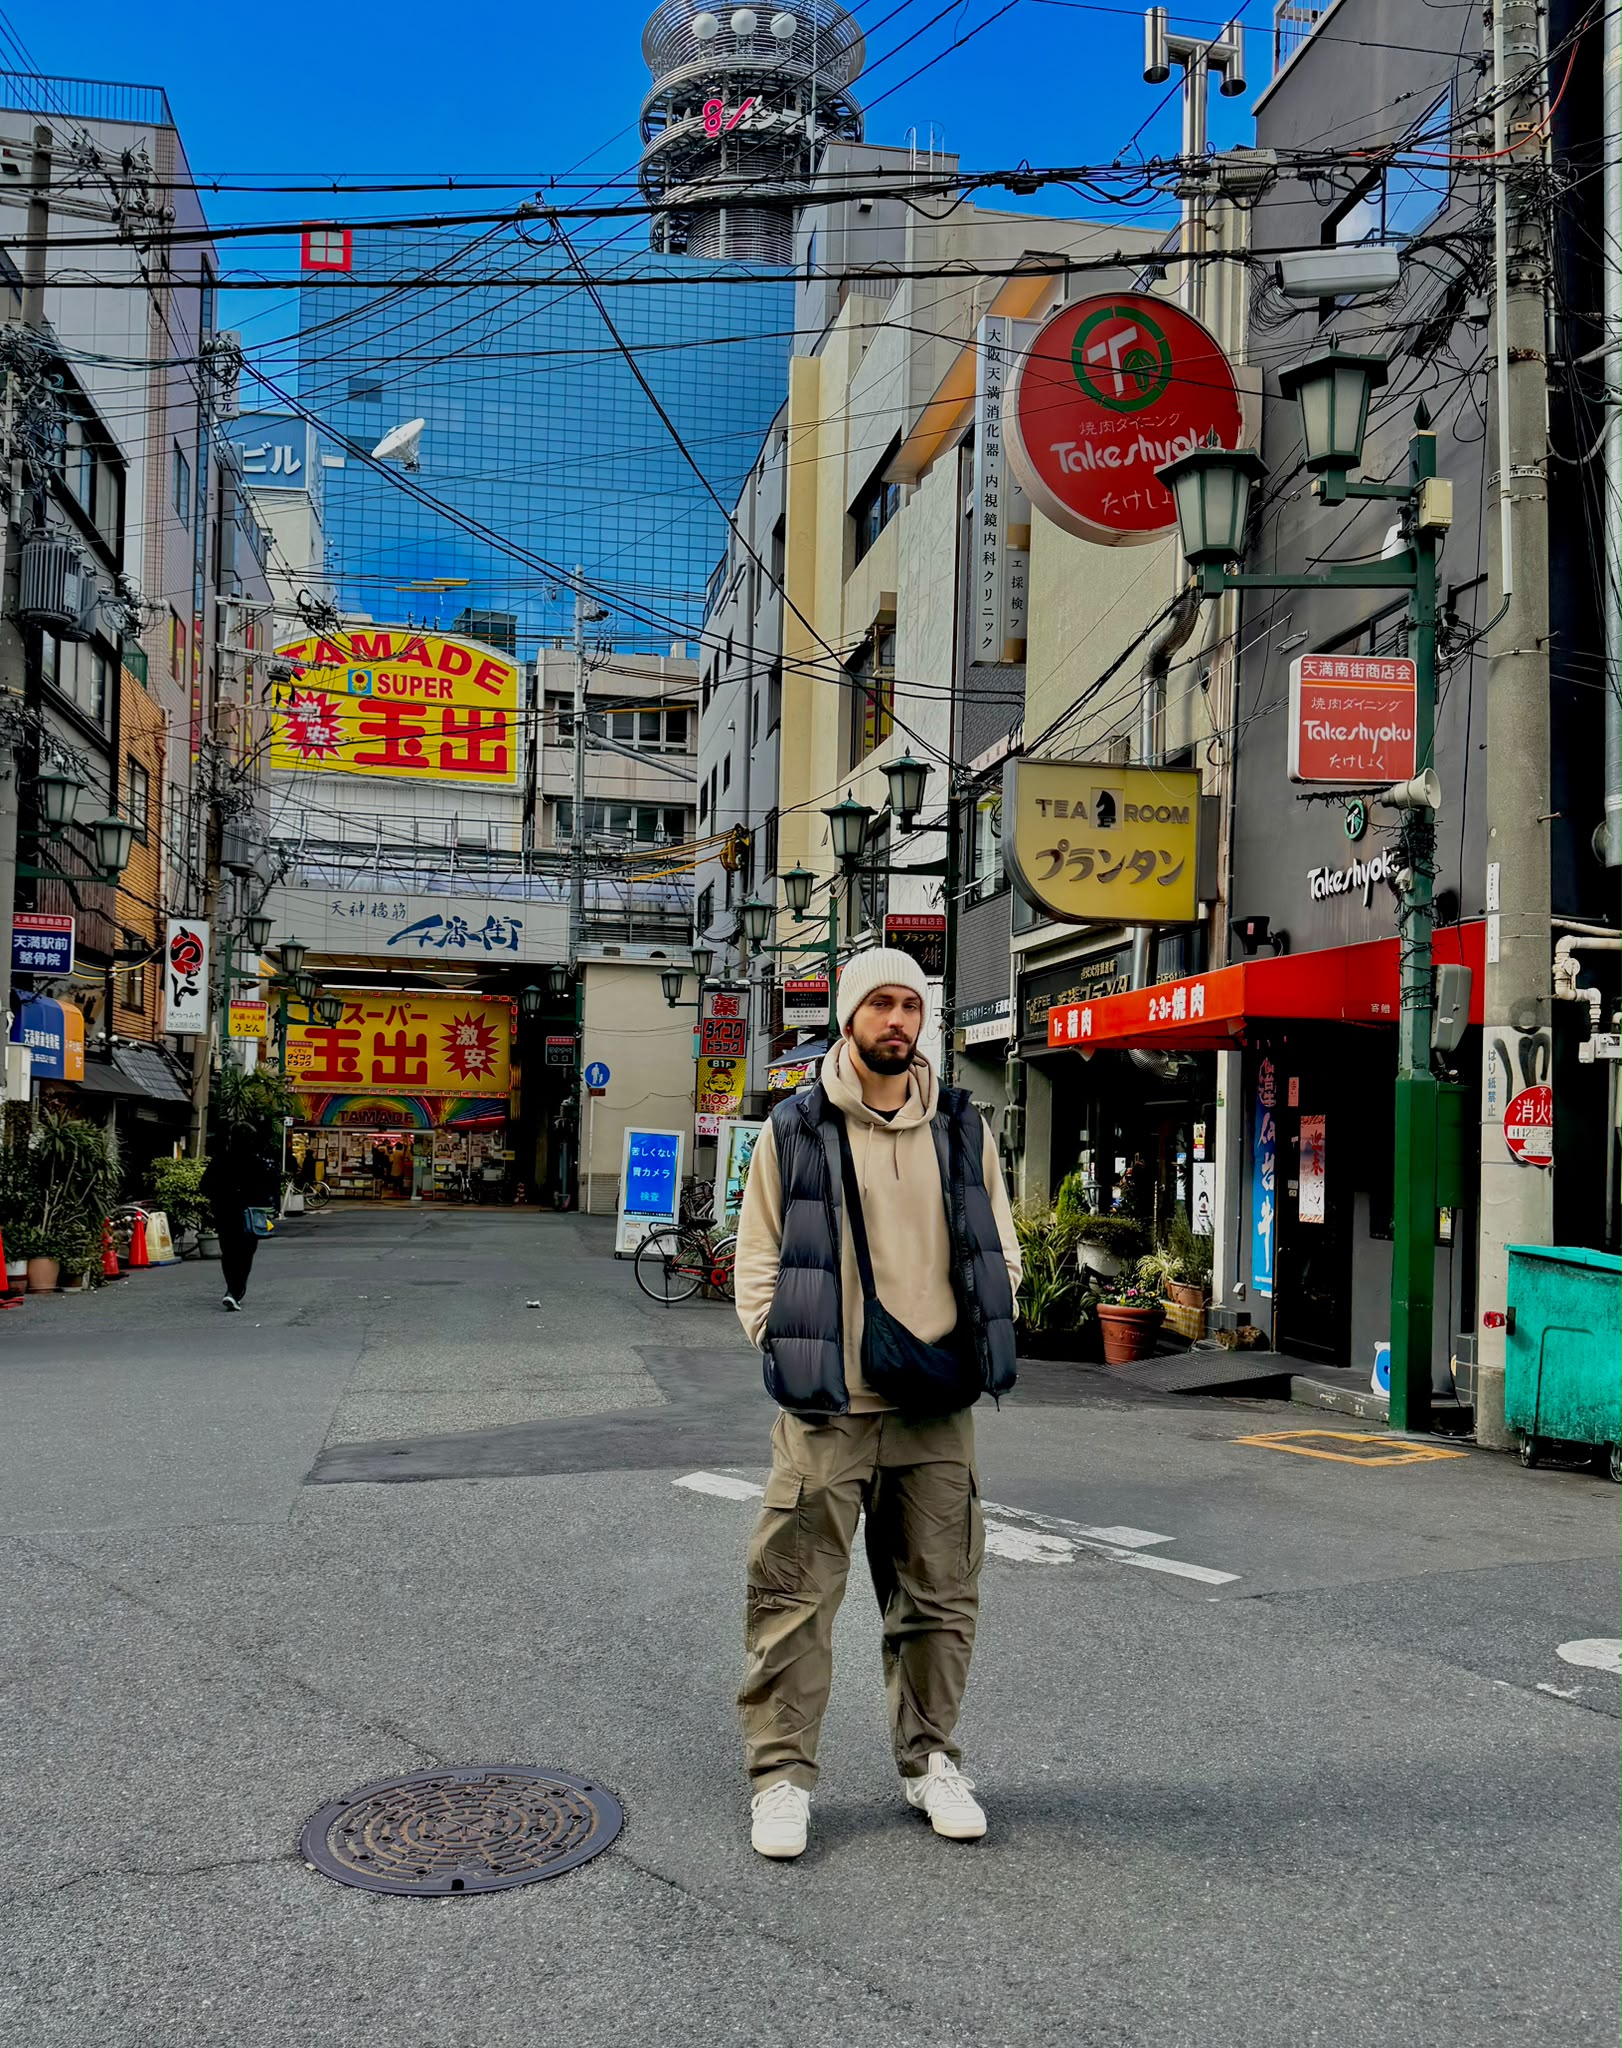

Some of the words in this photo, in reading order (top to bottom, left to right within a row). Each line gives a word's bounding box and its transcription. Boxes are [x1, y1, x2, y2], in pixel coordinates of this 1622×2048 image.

[1079, 411, 1184, 437] 焼肉ダイニング
[1303, 661, 1412, 681] 天満南街商店会
[377, 672, 454, 699] SUPER
[1311, 696, 1402, 713] 焼肉ダイニング
[353, 699, 508, 776] 玉出
[1302, 719, 1412, 754] Takeshyoku
[1329, 754, 1385, 770] たけしょく
[1035, 798, 1088, 820] TEA
[1124, 801, 1190, 824] ROOM
[1035, 838, 1186, 887] プランタン
[332, 900, 408, 920] 天神橋筋
[13, 934, 69, 951] 天満駅前
[19, 951, 61, 966] 整骨院
[343, 1003, 428, 1026] スーパー
[235, 1024, 260, 1033] うどん
[705, 1021, 744, 1040] ダイコク
[300, 1027, 429, 1085] 玉出
[455, 1024, 486, 1070] 激安
[1488, 1050, 1496, 1117] はり紙禁止
[338, 1110, 415, 1125] TAMADE
[1515, 1098, 1553, 1124] 消火
[631, 1146, 675, 1158] 苦しくない
